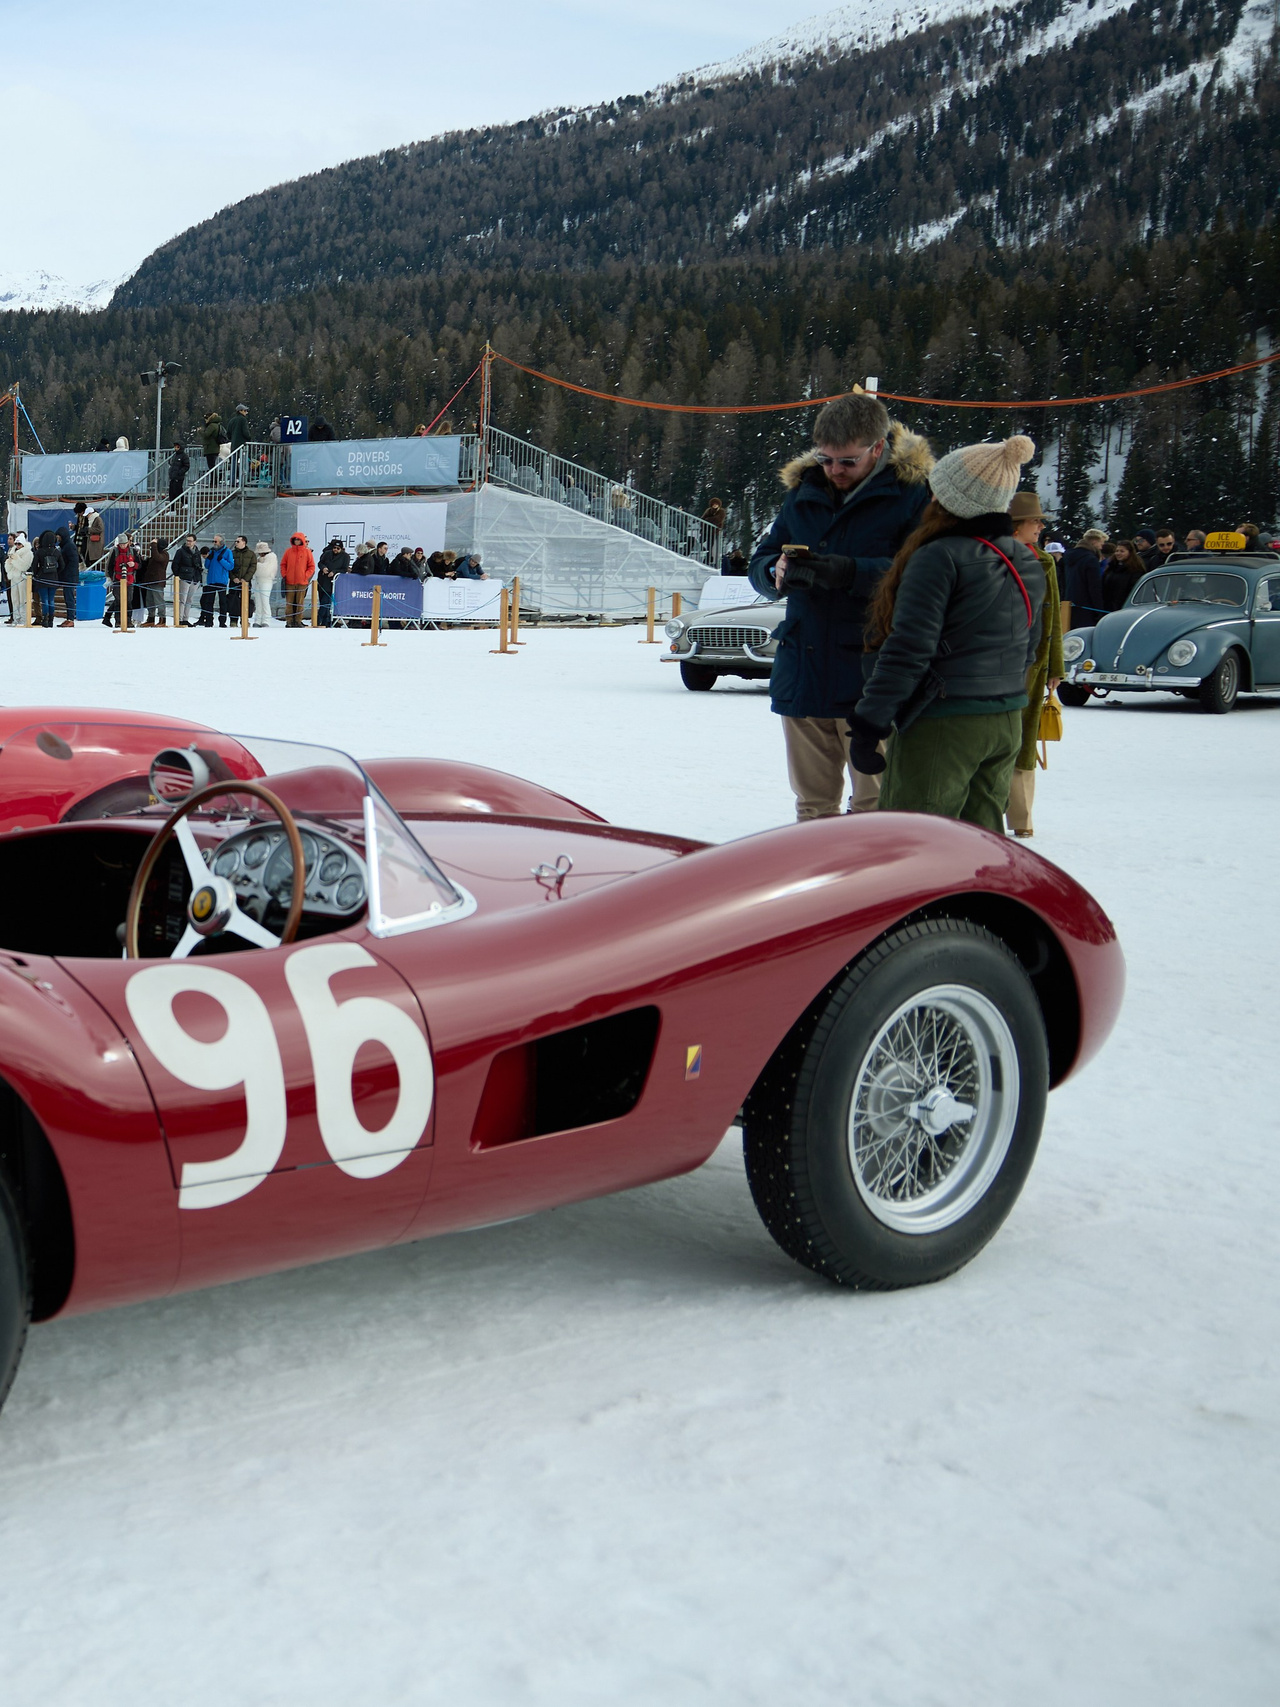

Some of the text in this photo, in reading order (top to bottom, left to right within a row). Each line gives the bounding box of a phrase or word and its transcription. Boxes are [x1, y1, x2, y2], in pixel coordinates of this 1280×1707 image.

[286, 420, 302, 435] A2
[348, 451, 390, 463] DRIVERS
[65, 463, 96, 473] DRIVERS
[336, 464, 402, 476] & SPONSORS
[66, 474, 108, 485] SPONSORS
[125, 942, 434, 1210] 96
